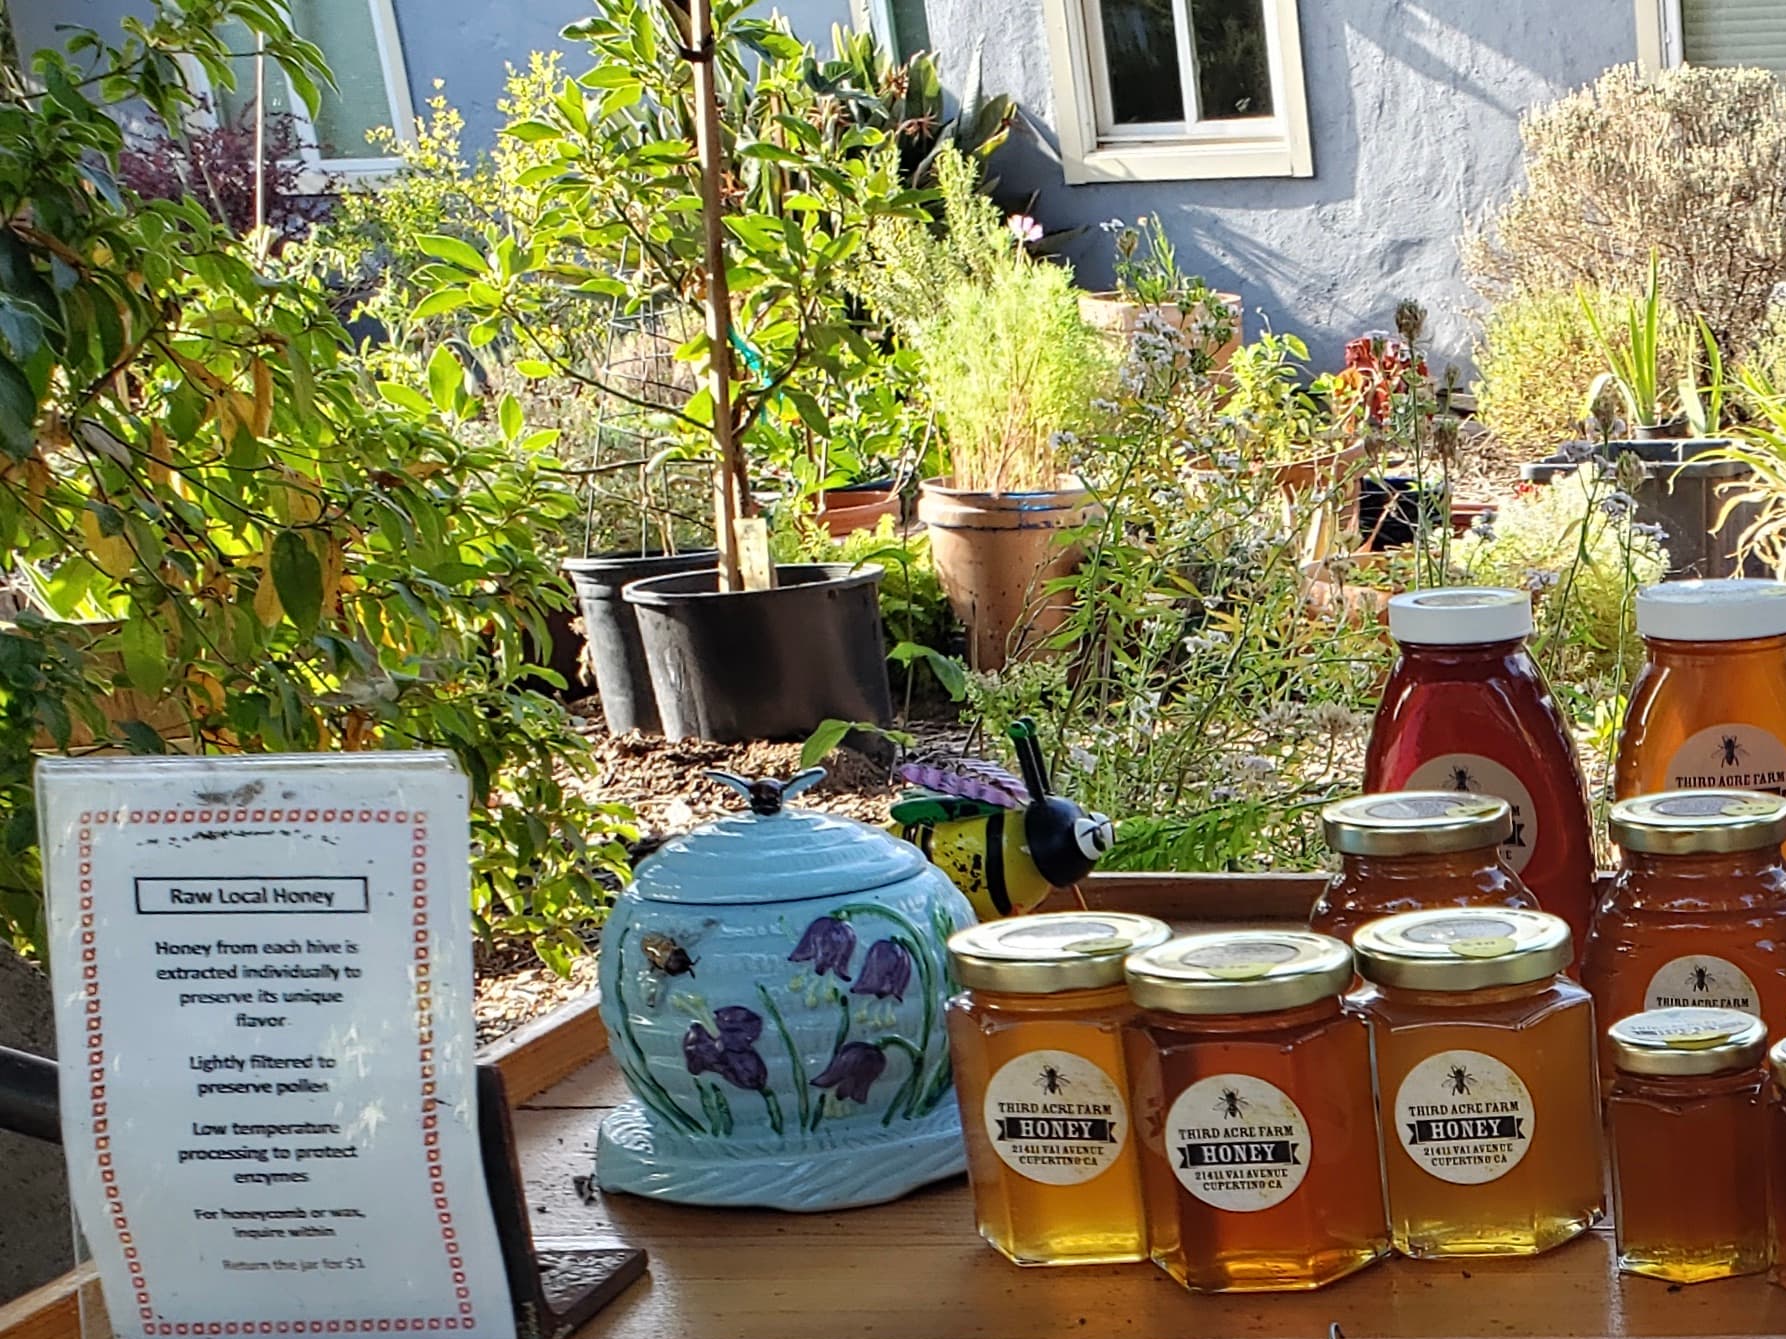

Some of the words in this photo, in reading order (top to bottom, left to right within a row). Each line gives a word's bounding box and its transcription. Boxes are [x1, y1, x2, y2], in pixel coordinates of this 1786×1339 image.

[1675, 776, 1716, 788] THIRD
[1718, 774, 1750, 787] ACRE
[1753, 771, 1785, 785] FARM
[170, 888, 212, 905] Raw
[218, 887, 267, 904] Local
[273, 888, 335, 907] Honey
[155, 941, 212, 958] Honey
[216, 940, 258, 954] from
[262, 940, 300, 954] each
[306, 940, 341, 954] hive
[347, 940, 359, 954] is
[156, 965, 237, 980] extracted
[242, 964, 340, 981] individually
[344, 966, 362, 978] to
[179, 992, 253, 1007] preserve
[257, 989, 277, 1003] its
[282, 989, 343, 1005] unique
[1656, 997, 1689, 1007] THIRD
[1691, 999, 1719, 1008] ACRE
[1720, 998, 1749, 1008] FARM
[235, 1013, 287, 1027] flavor
[189, 1055, 245, 1073] Lightly
[250, 1054, 313, 1069] filtered
[318, 1056, 336, 1069] to
[198, 1082, 273, 1097] preserve
[276, 1079, 329, 1095] pollen
[998, 1102, 1039, 1114] THIRD
[1042, 1104, 1074, 1114] ACRE
[1076, 1104, 1112, 1115] FARM
[1408, 1104, 1448, 1117] THIRD
[1451, 1103, 1484, 1115] ACRE
[1486, 1101, 1519, 1113] FARM
[192, 1122, 227, 1136] Low
[232, 1122, 340, 1138] temperature
[1020, 1120, 1093, 1138] HONEY
[1178, 1128, 1220, 1140] THIRD
[1224, 1126, 1256, 1138] ACRE
[1258, 1125, 1294, 1137] FARM
[1430, 1119, 1501, 1139] HONEY
[178, 1145, 269, 1163] processing
[273, 1147, 291, 1160] to
[296, 1145, 358, 1161] protect
[1012, 1145, 1039, 1154] 21411
[1041, 1145, 1060, 1154] VAI
[1063, 1146, 1104, 1155] AVENUE
[1201, 1144, 1275, 1163] HONEY
[1424, 1146, 1451, 1156] 21411
[1453, 1145, 1470, 1154] VAI
[1473, 1143, 1513, 1153] AVENUE
[1019, 1155, 1080, 1165] CUPERTINO
[1081, 1157, 1098, 1166] CA
[1431, 1156, 1491, 1166] CUPERTINO
[1494, 1154, 1508, 1163] CA
[234, 1172, 310, 1185] enzymes
[1195, 1170, 1224, 1180] 21411
[1225, 1170, 1244, 1179] VAI
[1246, 1169, 1288, 1178] AVENUE
[1203, 1180, 1265, 1191] CUPERTINO
[1268, 1180, 1283, 1188] CA
[194, 1209, 218, 1220] For
[220, 1207, 307, 1221] honeycomb
[311, 1209, 325, 1218] or
[232, 1227, 285, 1240] inquire
[288, 1225, 336, 1237] within
[222, 1259, 270, 1271] Return
[273, 1259, 297, 1270] the
[302, 1260, 318, 1272] jar
[323, 1258, 343, 1269] for
